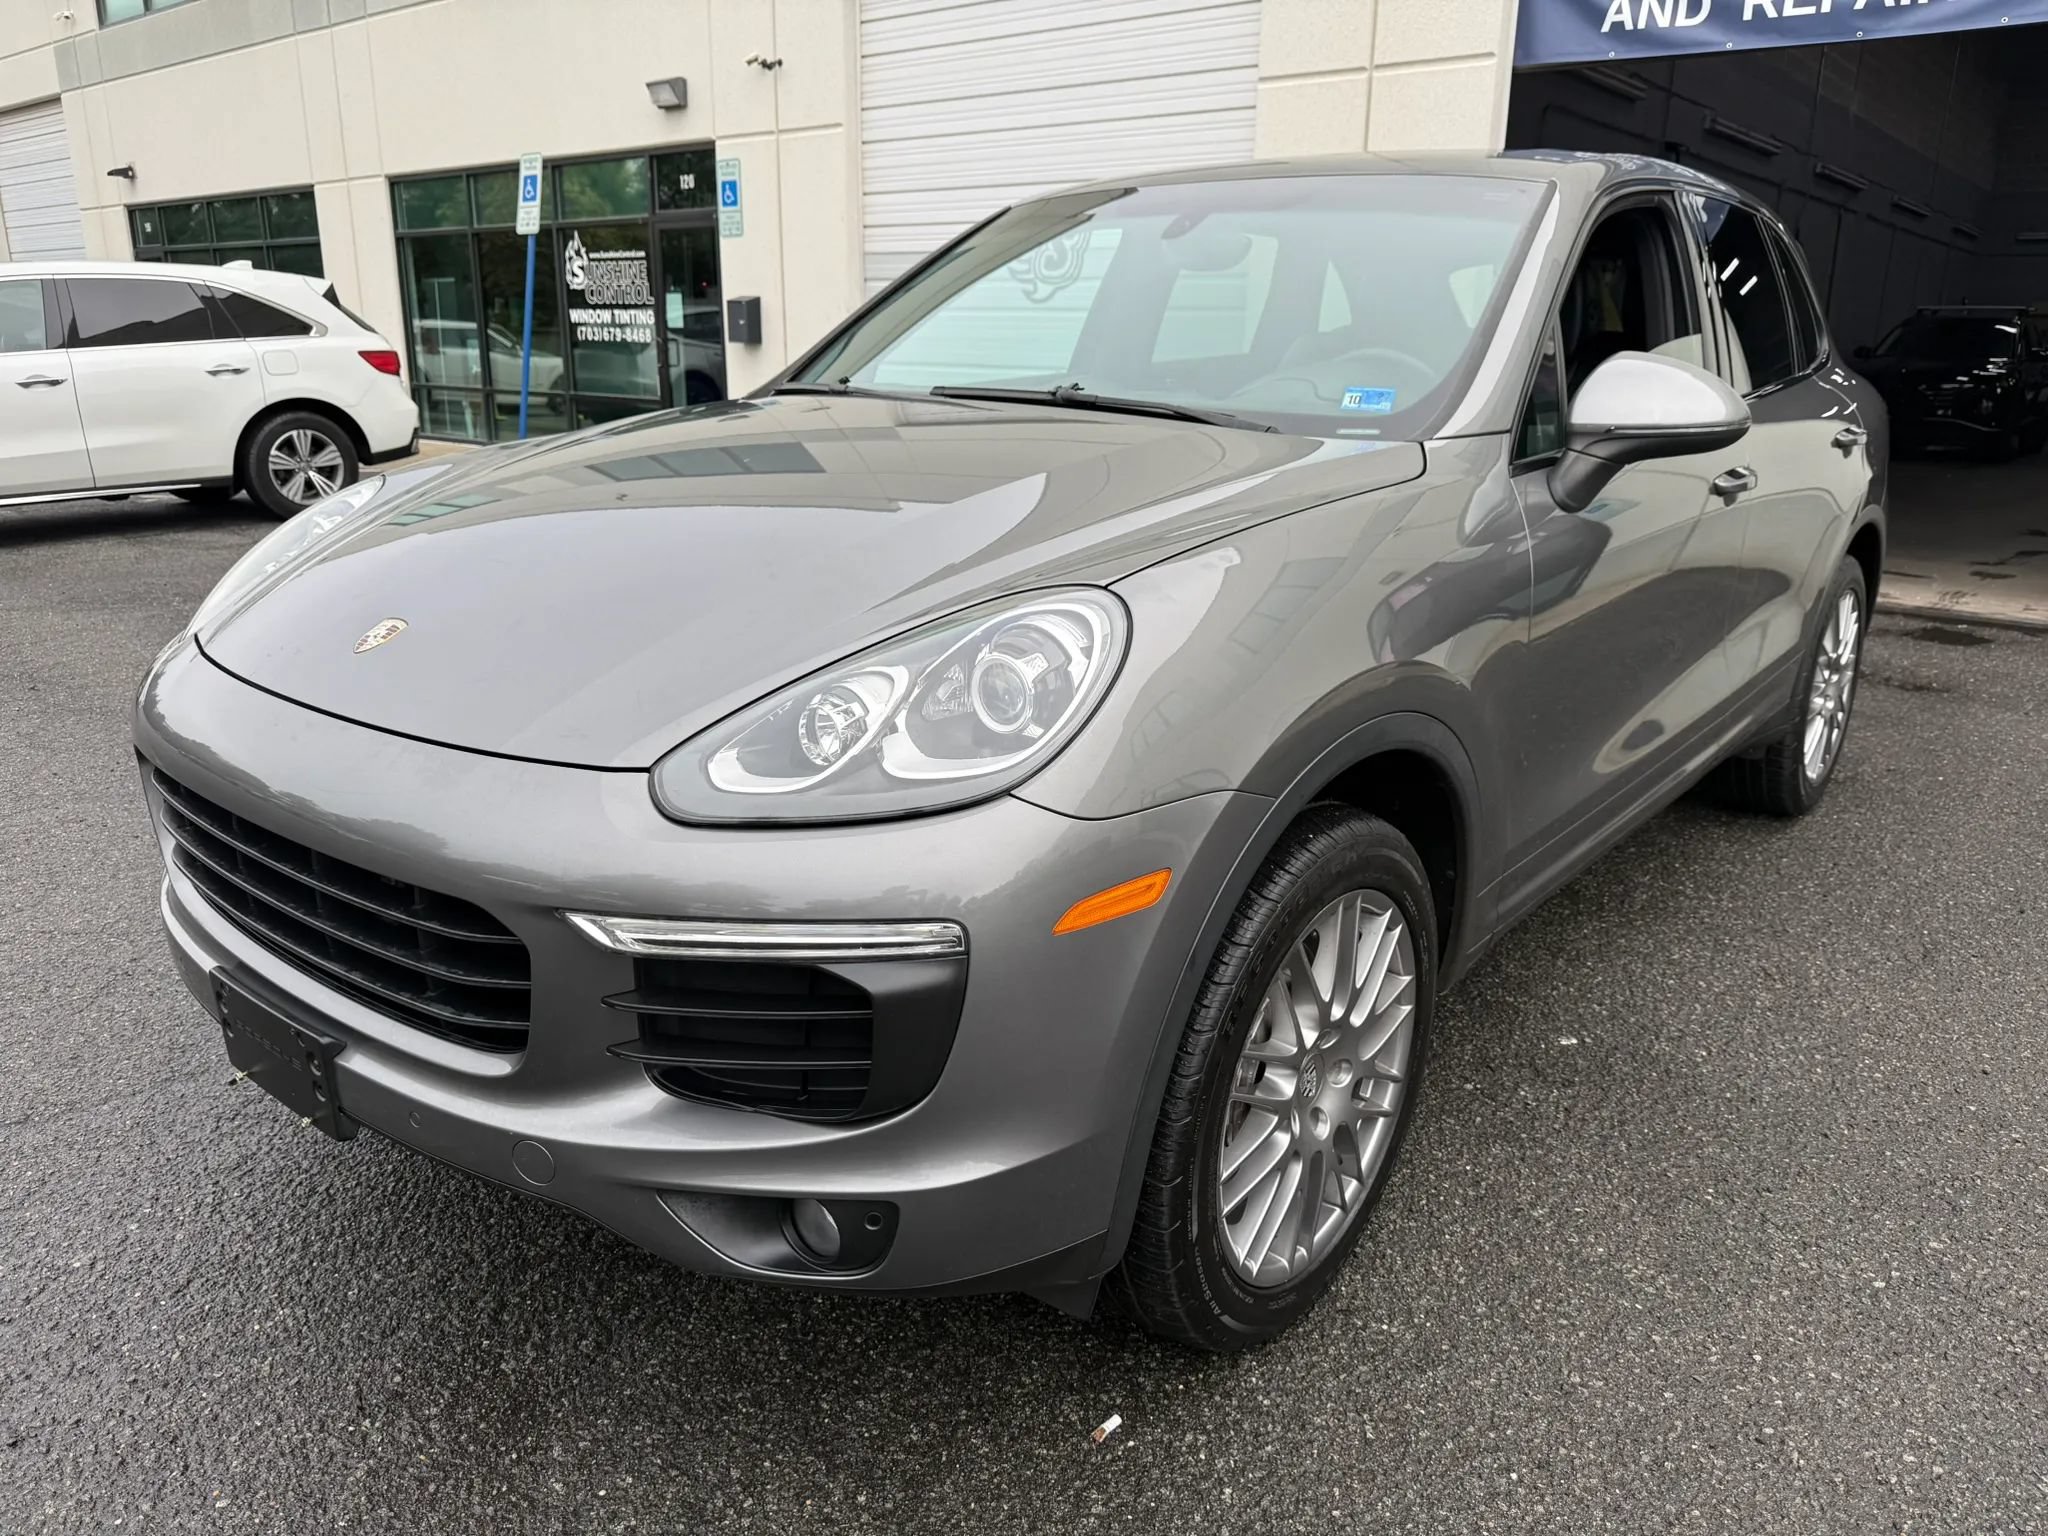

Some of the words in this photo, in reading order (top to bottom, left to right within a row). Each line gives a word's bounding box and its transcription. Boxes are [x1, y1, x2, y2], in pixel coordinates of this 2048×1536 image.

[1600, 0, 1712, 33] AND
[679, 174, 696, 190] 120
[572, 260, 648, 285] SUNSHINE
[585, 282, 655, 304] CONTROL
[569, 309, 612, 324] WINDOW
[613, 309, 655, 324] TINTING
